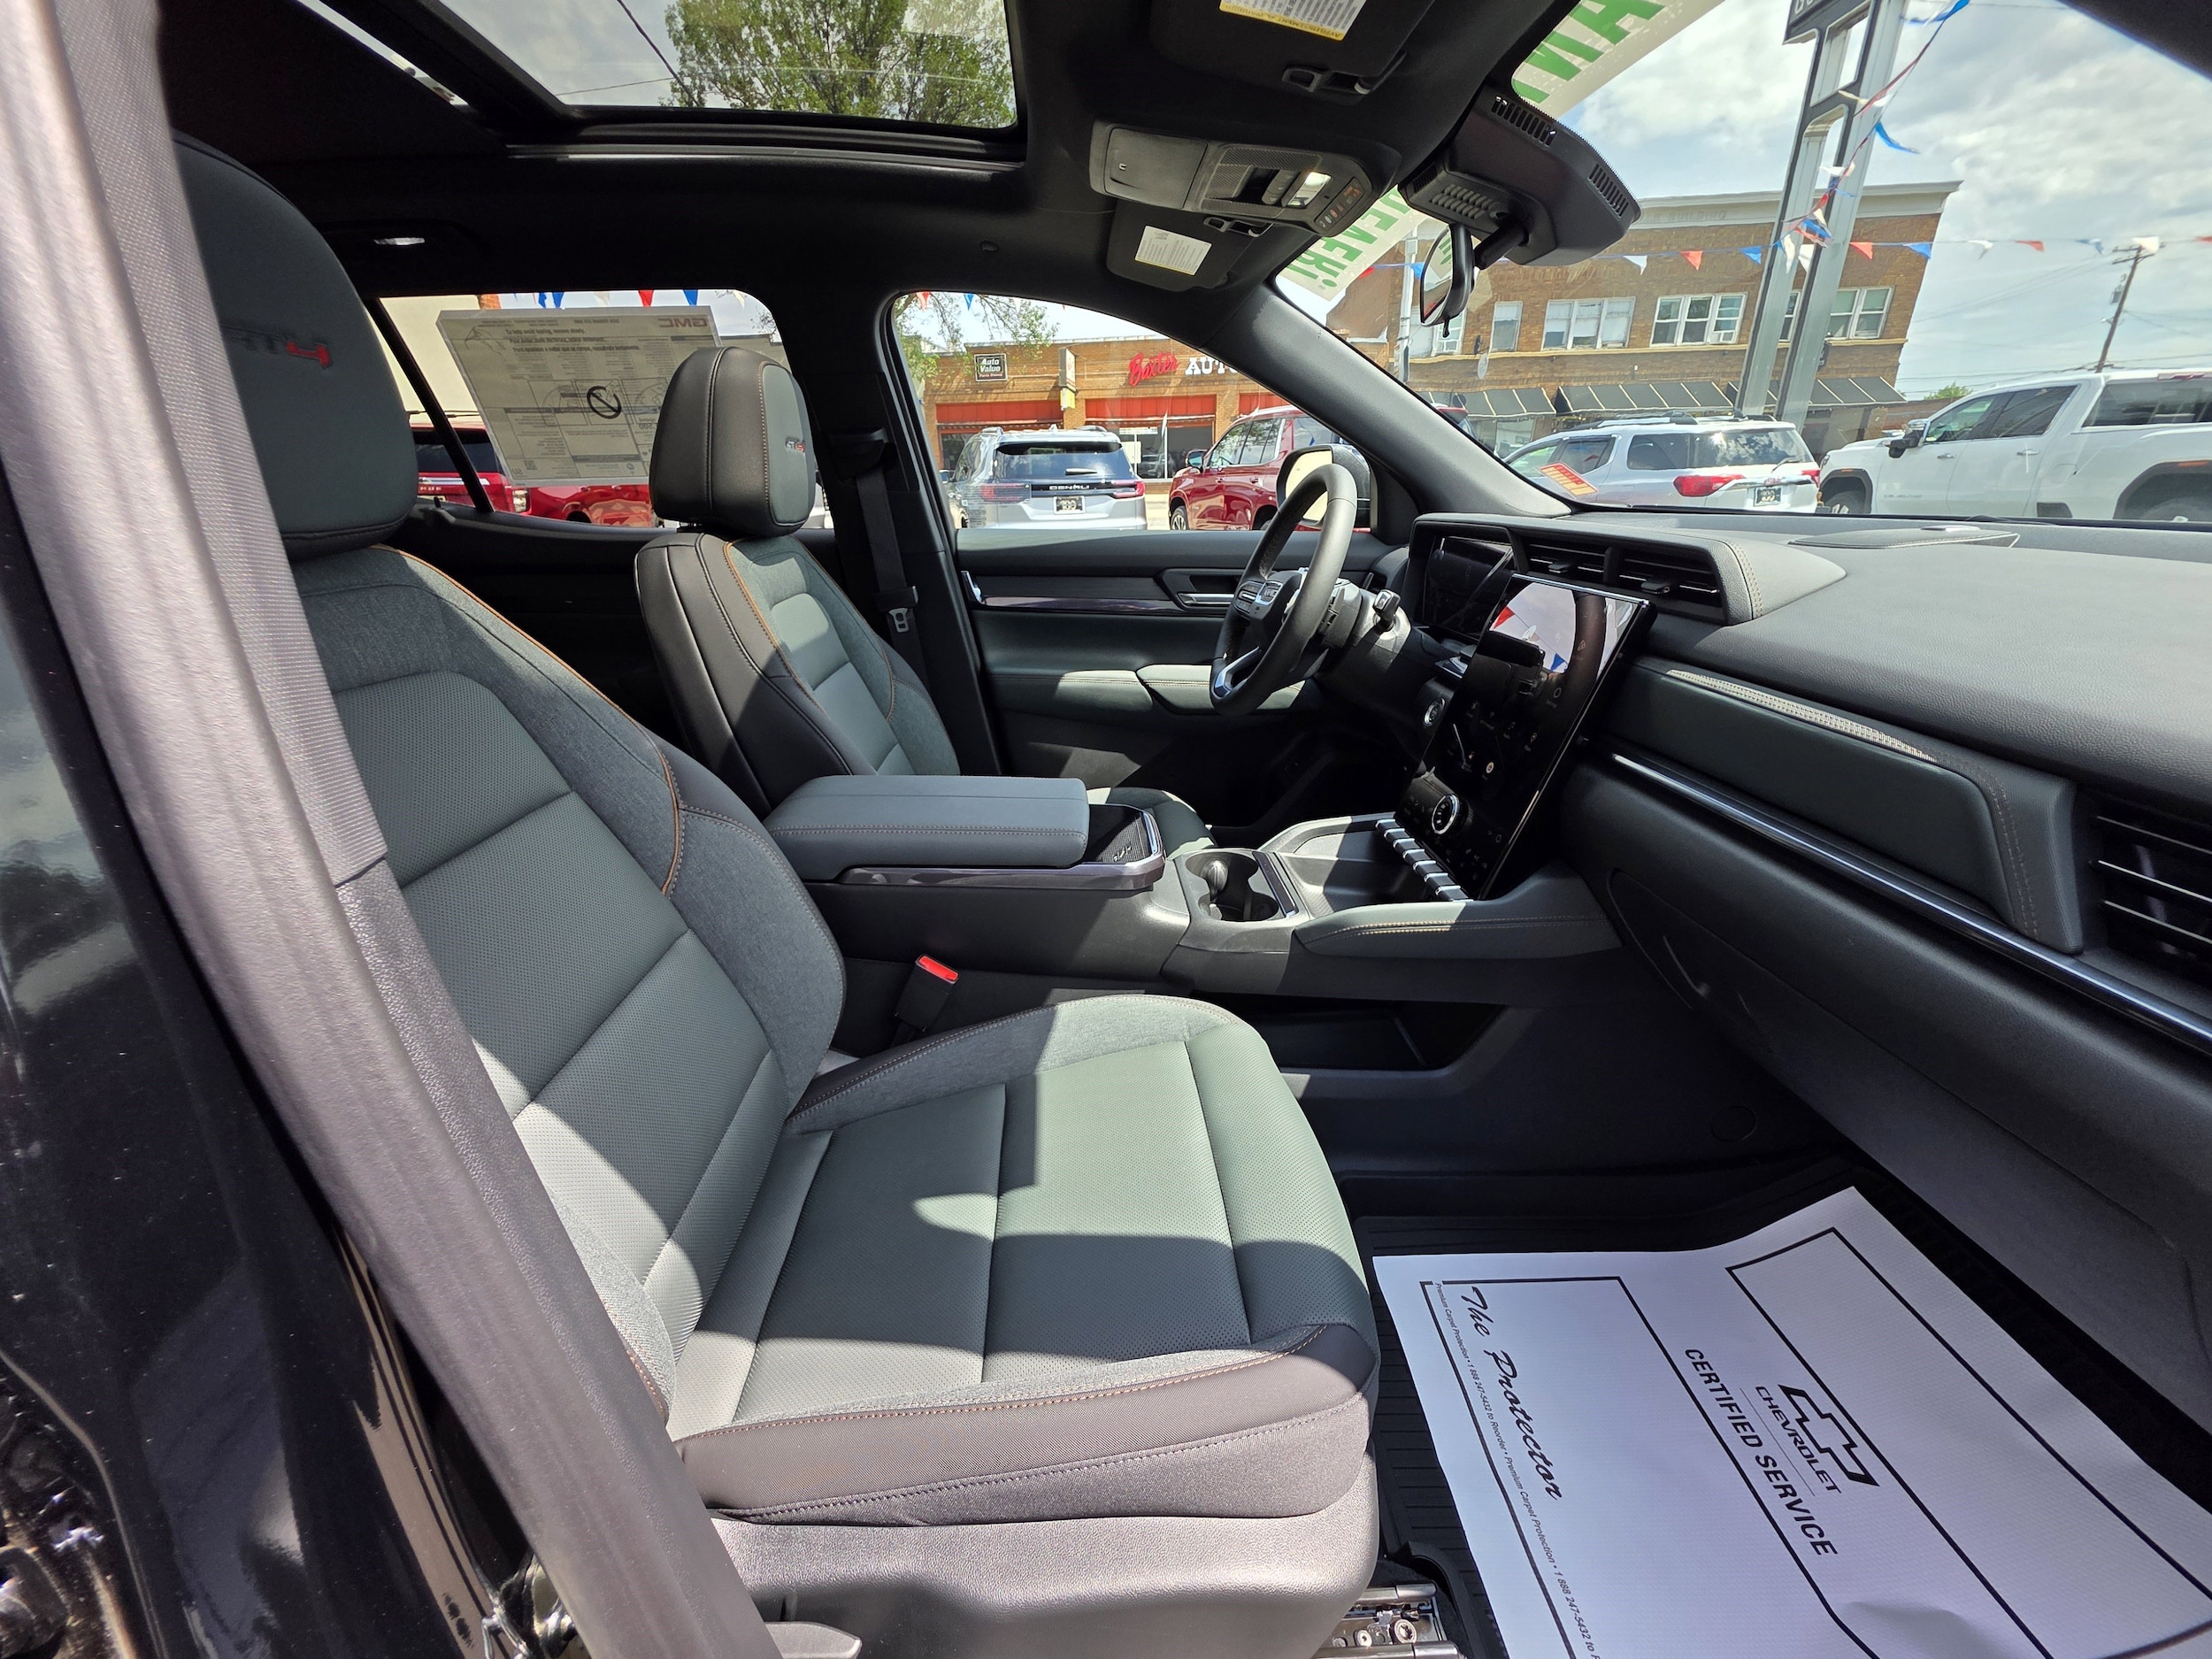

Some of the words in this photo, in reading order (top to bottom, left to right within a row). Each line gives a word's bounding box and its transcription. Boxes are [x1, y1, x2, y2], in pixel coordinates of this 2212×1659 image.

[1128, 351, 1179, 387] Baxter
[1435, 1282, 1448, 1309] Premium
[1445, 1309, 1457, 1328] Carpet
[1452, 1328, 1470, 1359] Protection
[1470, 1368, 1480, 1381] 888
[1461, 1286, 1494, 1337] The
[1483, 1349, 1563, 1501] Protector
[1474, 1380, 1493, 1412] 247-5432
[1486, 1411, 1494, 1420] to
[1490, 1421, 1507, 1451] Reorder
[1685, 1348, 1763, 1448] CERTIFIED
[1755, 1454, 1839, 1555] SERVICE
[1755, 1386, 1842, 1494] CHEVROLET
[1504, 1456, 1524, 1490] Premium
[1520, 1491, 1538, 1517] Carpet
[1532, 1518, 1555, 1563] Protection
[1557, 1578, 1571, 1594] 888
[1565, 1596, 1592, 1640] 247-5432
[1585, 1641, 1595, 1652] to
